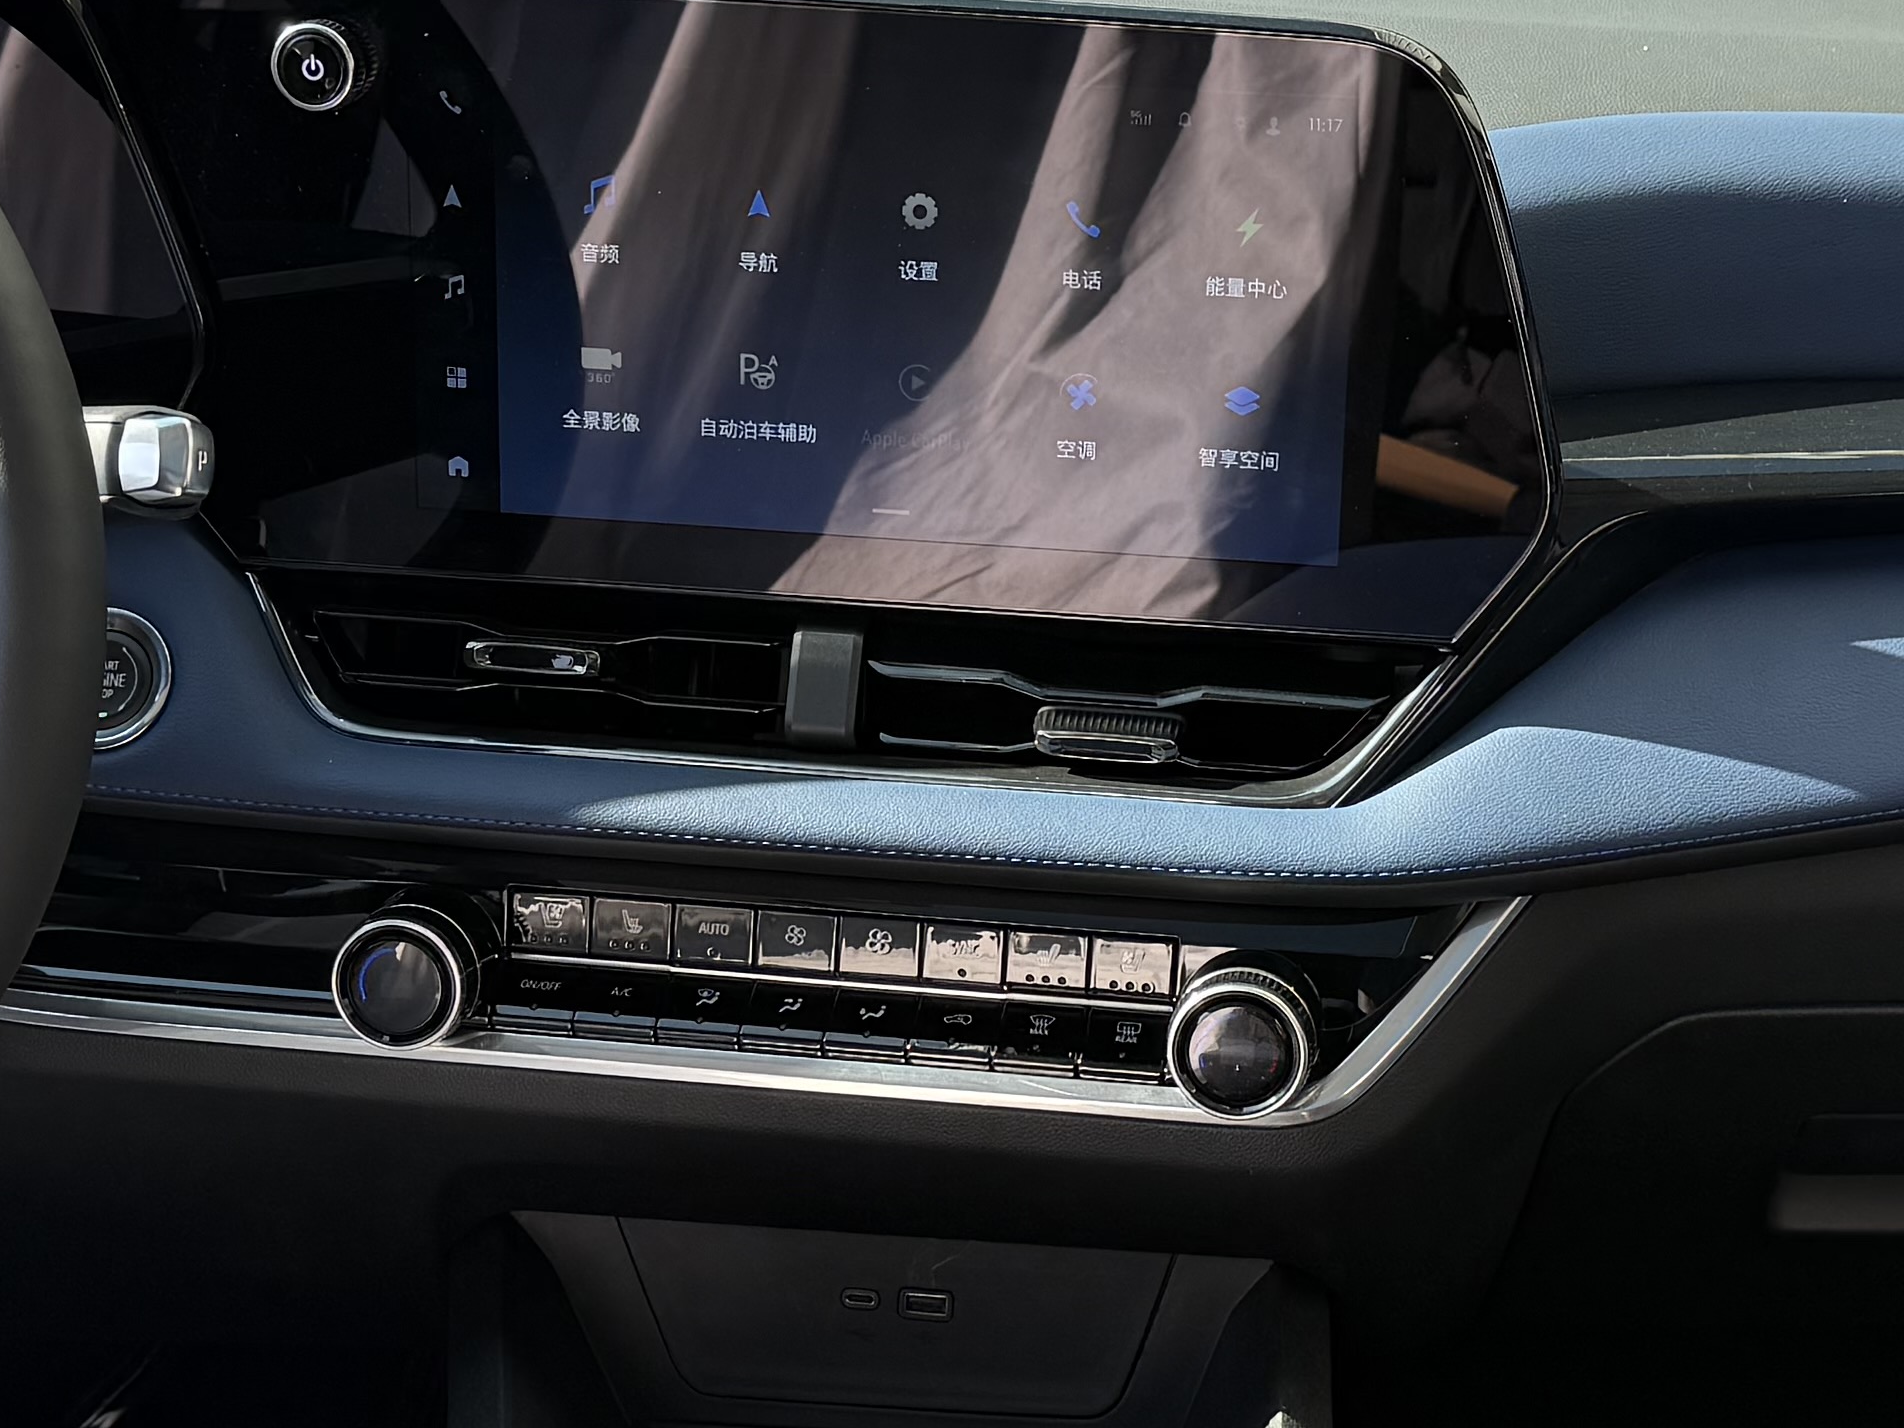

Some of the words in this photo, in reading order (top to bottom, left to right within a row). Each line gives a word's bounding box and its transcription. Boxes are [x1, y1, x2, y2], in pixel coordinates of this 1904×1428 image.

[1308, 118, 1344, 132] 11:17
[581, 243, 620, 264] 音频
[739, 252, 778, 273] 导航
[899, 261, 938, 282] 设置
[1062, 269, 1102, 290] 电话
[1205, 276, 1288, 300] 能量中心
[563, 409, 641, 433] 全景影像
[700, 418, 817, 443] 自动泊车辅助
[861, 428, 907, 450] Apple
[1056, 440, 1097, 461] 空调
[1198, 448, 1280, 472] 智享空间
[698, 921, 730, 937] AUTO
